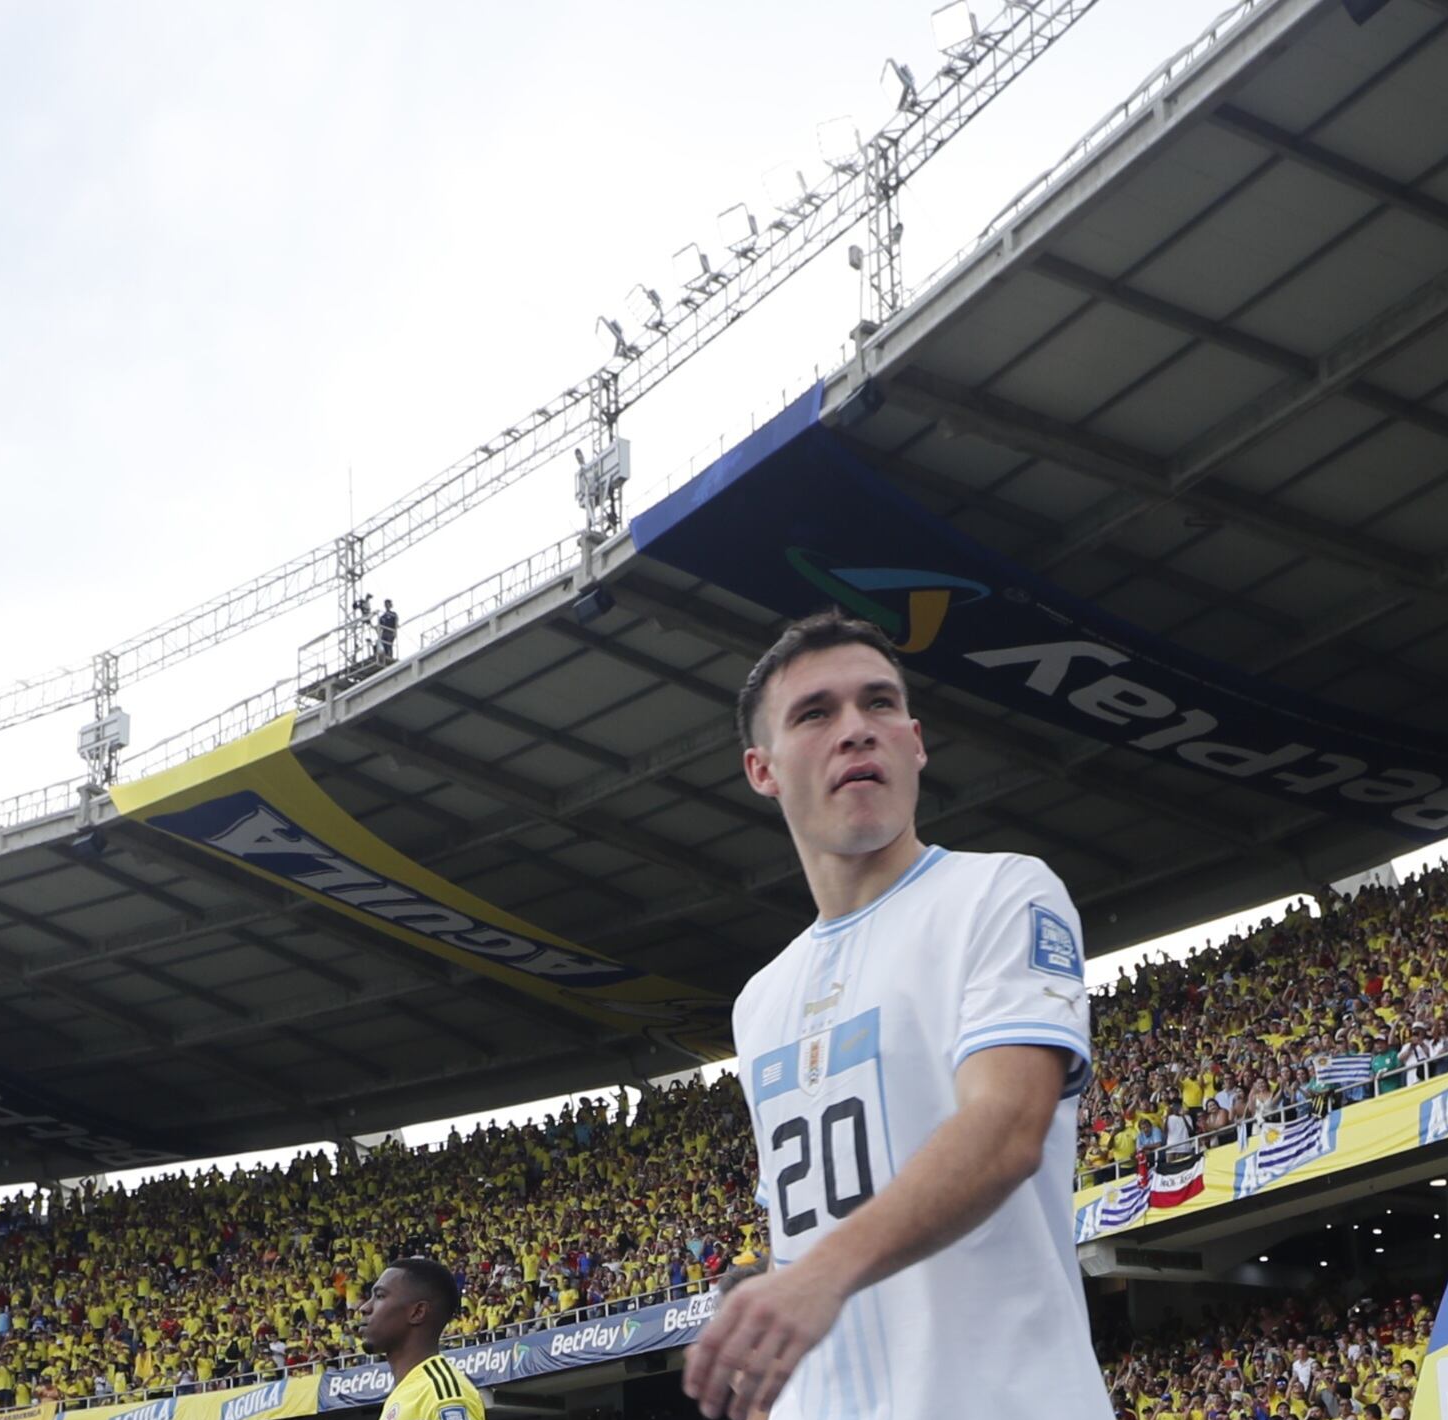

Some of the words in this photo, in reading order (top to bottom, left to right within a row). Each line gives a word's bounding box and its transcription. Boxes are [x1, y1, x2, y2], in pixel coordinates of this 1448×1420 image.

[204, 805, 628, 975] AGUILA
[772, 1097, 874, 1237] 20
[551, 1325, 620, 1356] BetPlay
[329, 1370, 394, 1397] BetPlay
